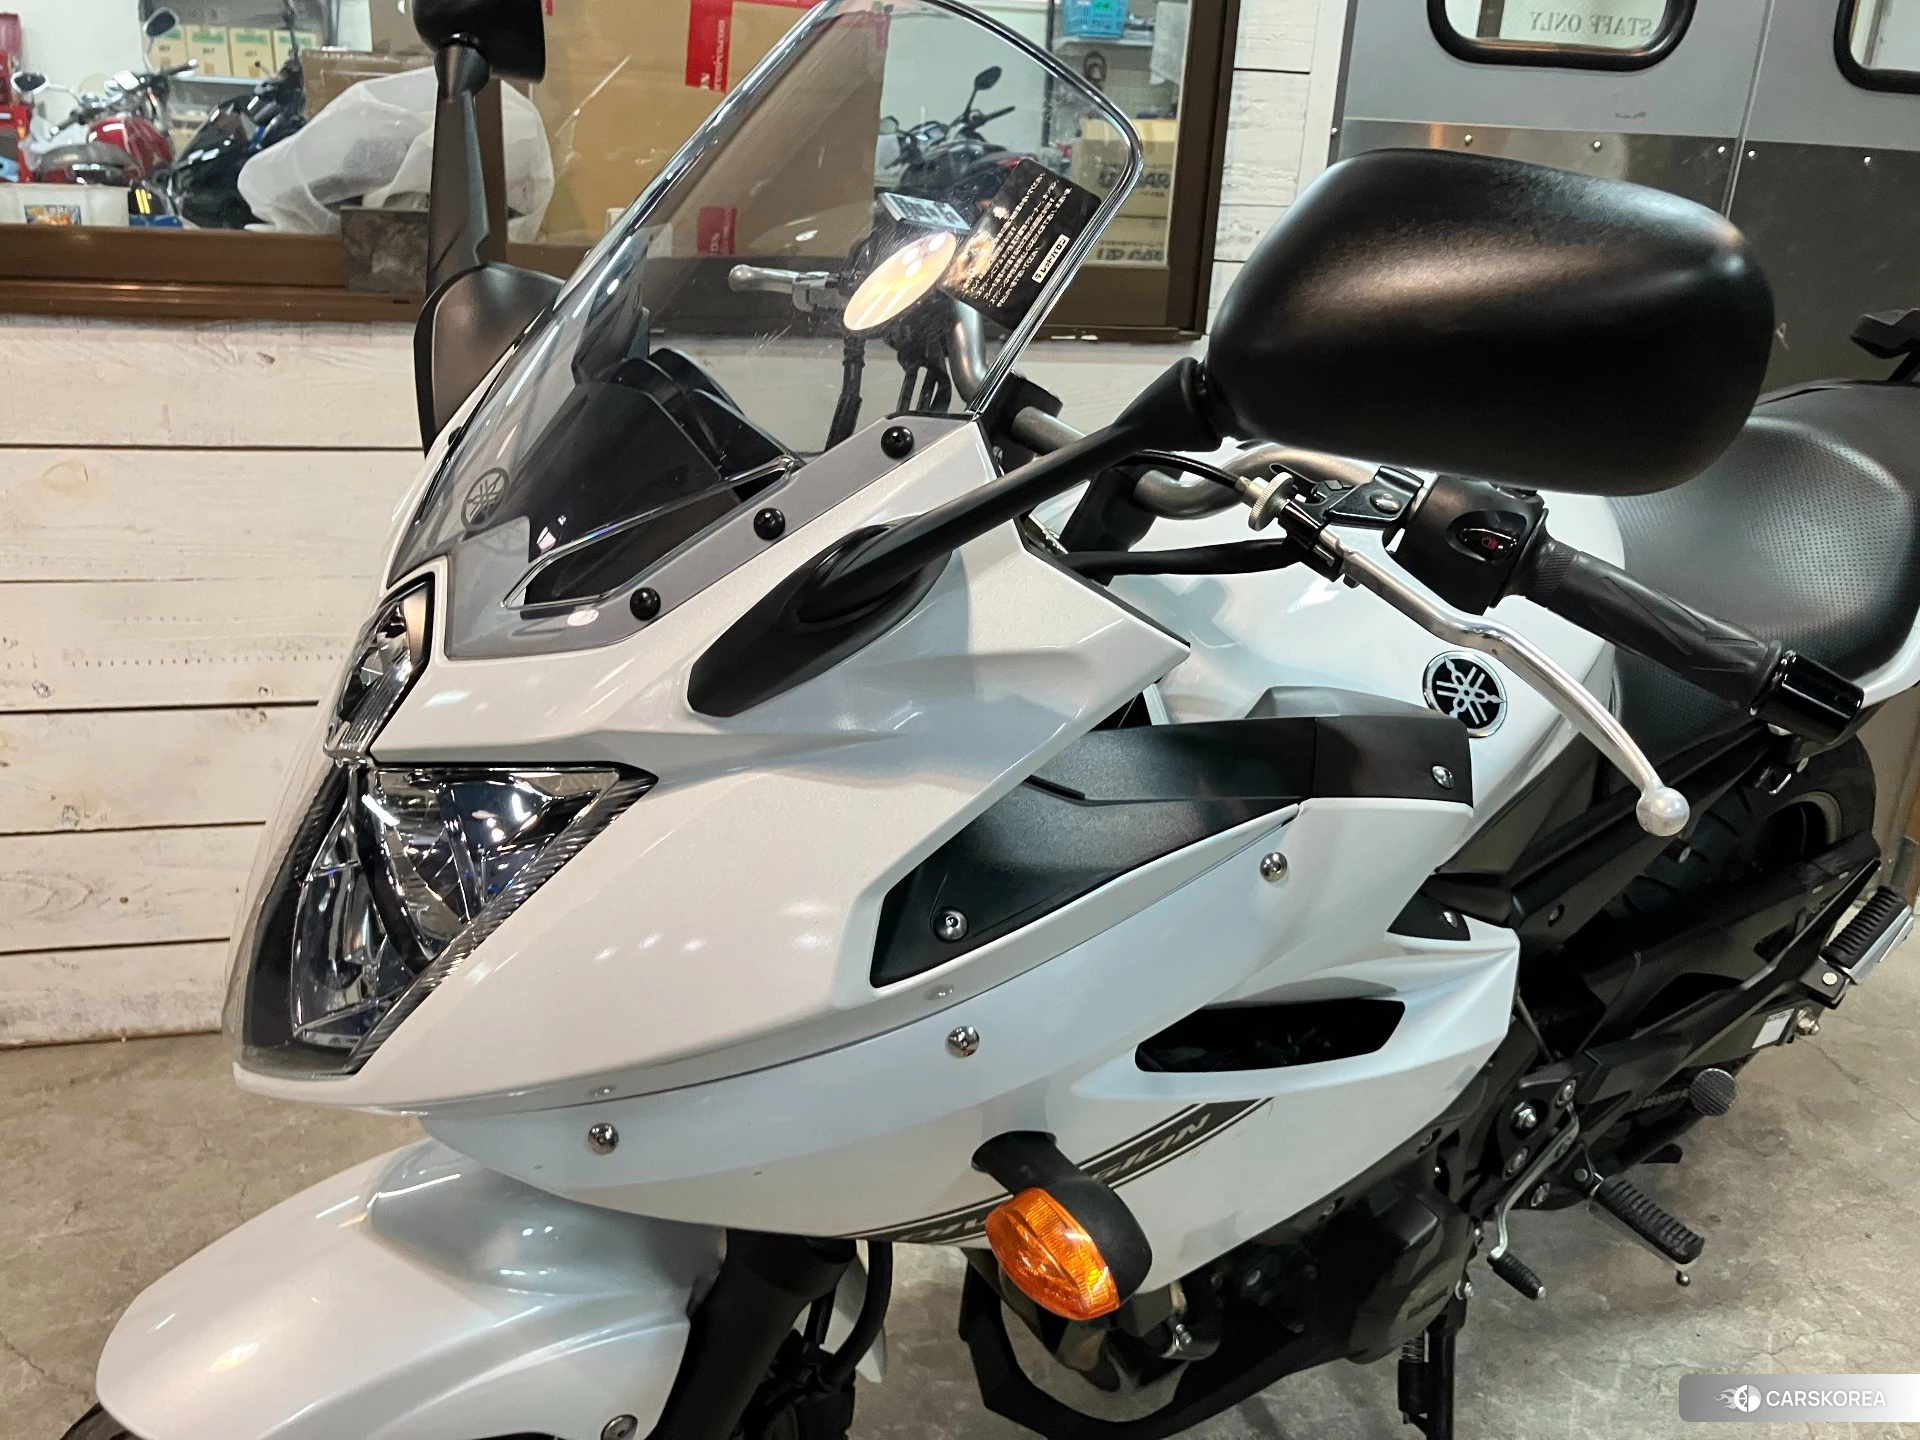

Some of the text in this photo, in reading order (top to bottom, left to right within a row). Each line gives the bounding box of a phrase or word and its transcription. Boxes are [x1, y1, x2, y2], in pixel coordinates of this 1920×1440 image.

[1039, 237, 1066, 273] レッドバロン
